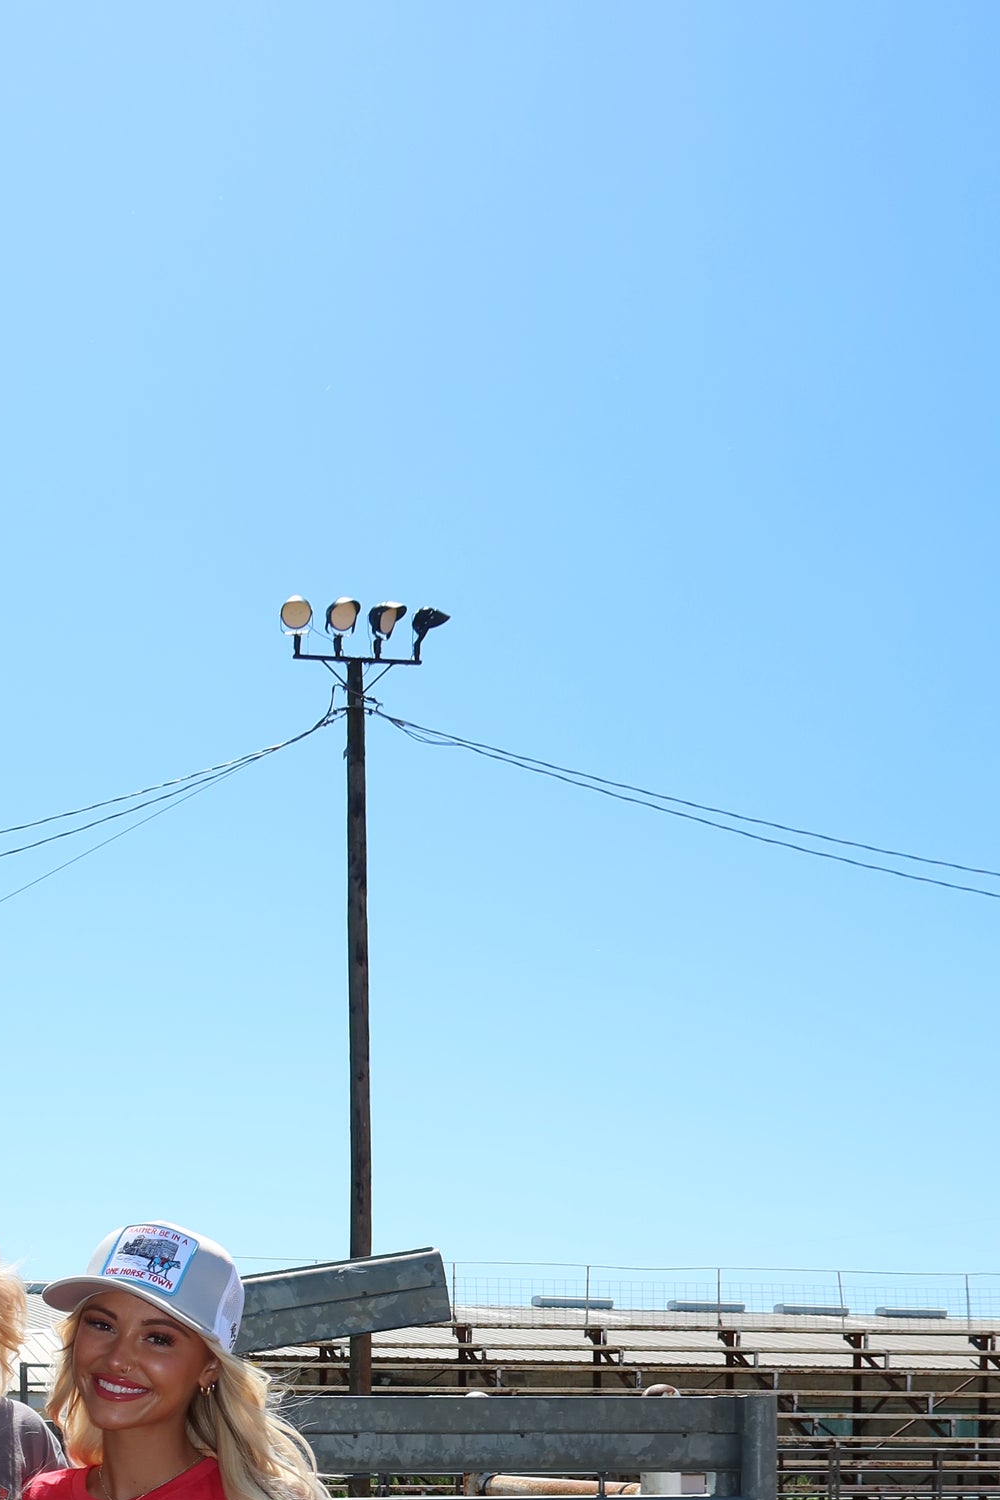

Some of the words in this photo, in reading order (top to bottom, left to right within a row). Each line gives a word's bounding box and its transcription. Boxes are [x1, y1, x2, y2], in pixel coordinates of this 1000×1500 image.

[159, 1230, 171, 1238] BE
[171, 1233, 181, 1242] IN
[105, 1267, 119, 1276] ONE
[120, 1268, 146, 1279] HORSE
[148, 1273, 173, 1290] TOWN
